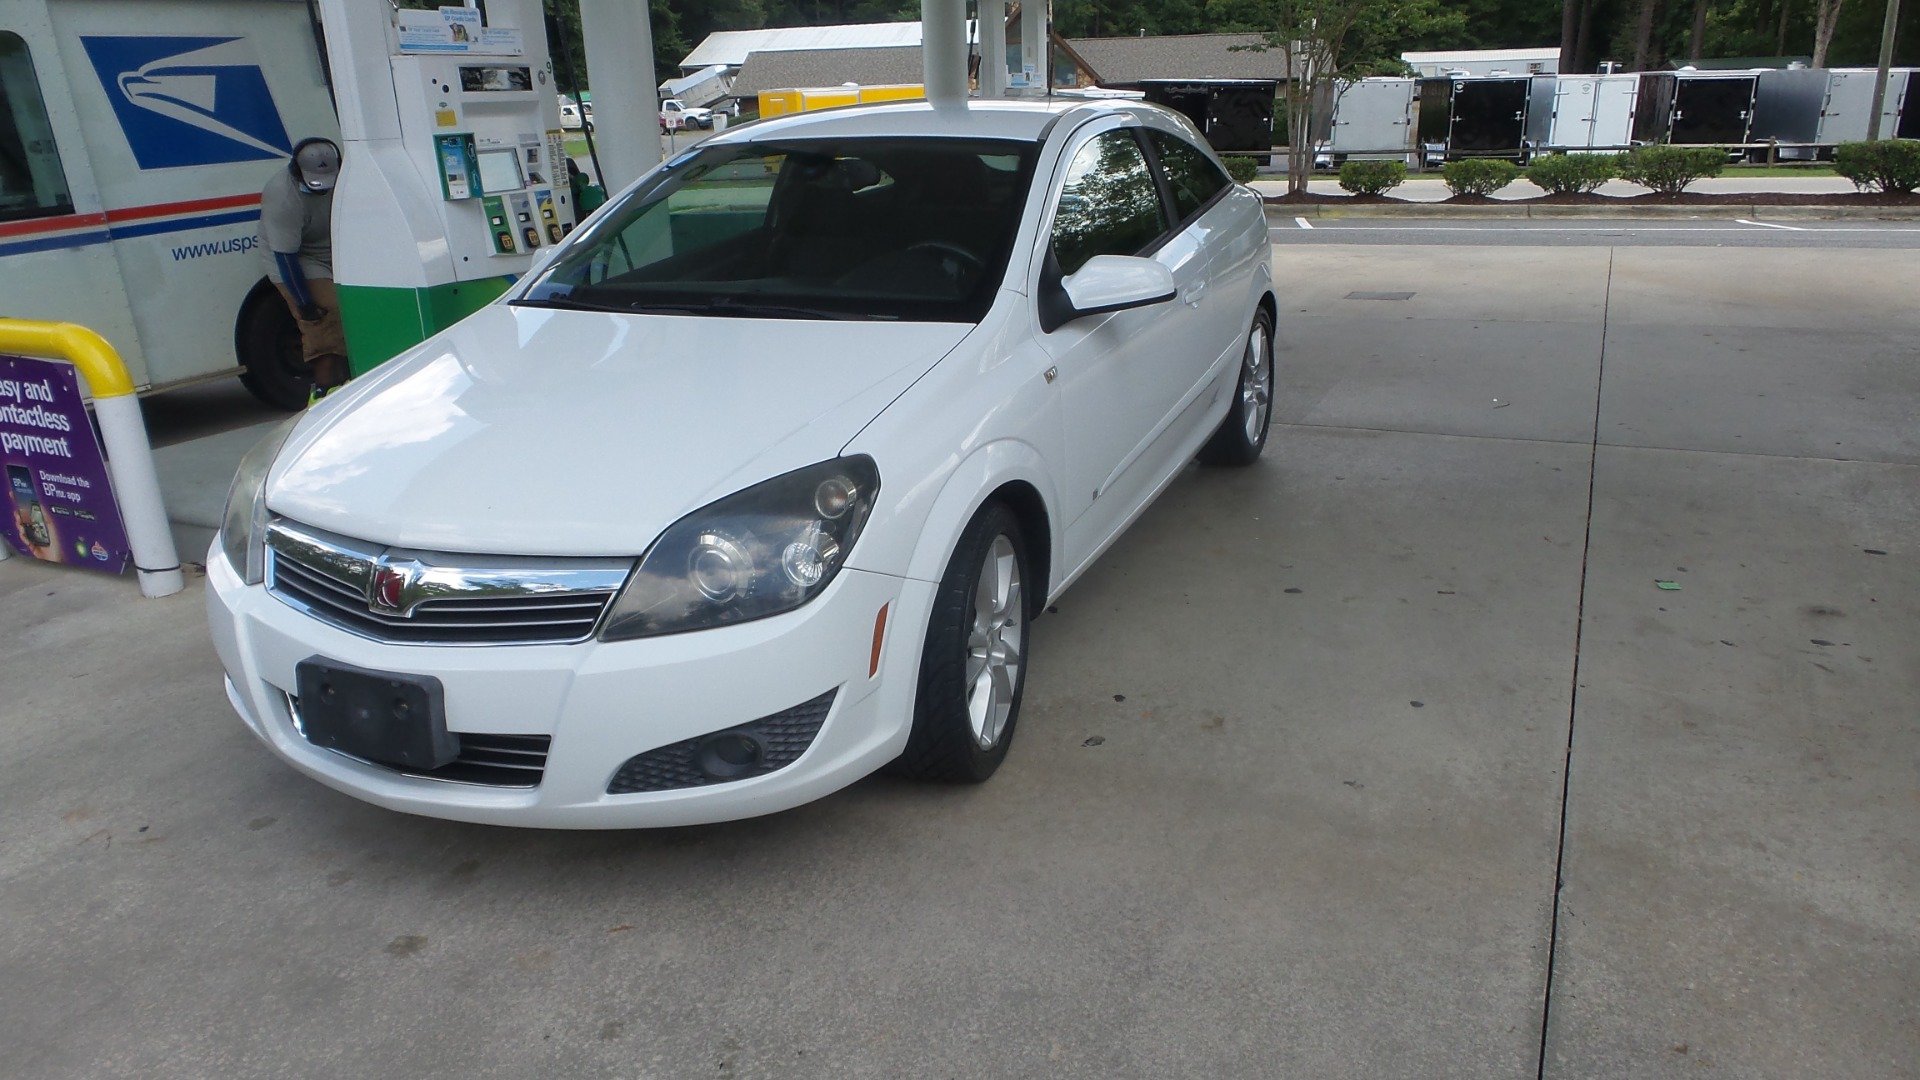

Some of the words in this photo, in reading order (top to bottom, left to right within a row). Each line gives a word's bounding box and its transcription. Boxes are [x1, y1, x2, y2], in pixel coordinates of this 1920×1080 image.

[546, 61, 552, 74] 9
[172, 235, 258, 261] www.usps
[23, 379, 54, 403] and
[0, 432, 71, 458] payment
[39, 470, 77, 486] Download
[76, 477, 90, 488] the
[66, 491, 81, 503] app
